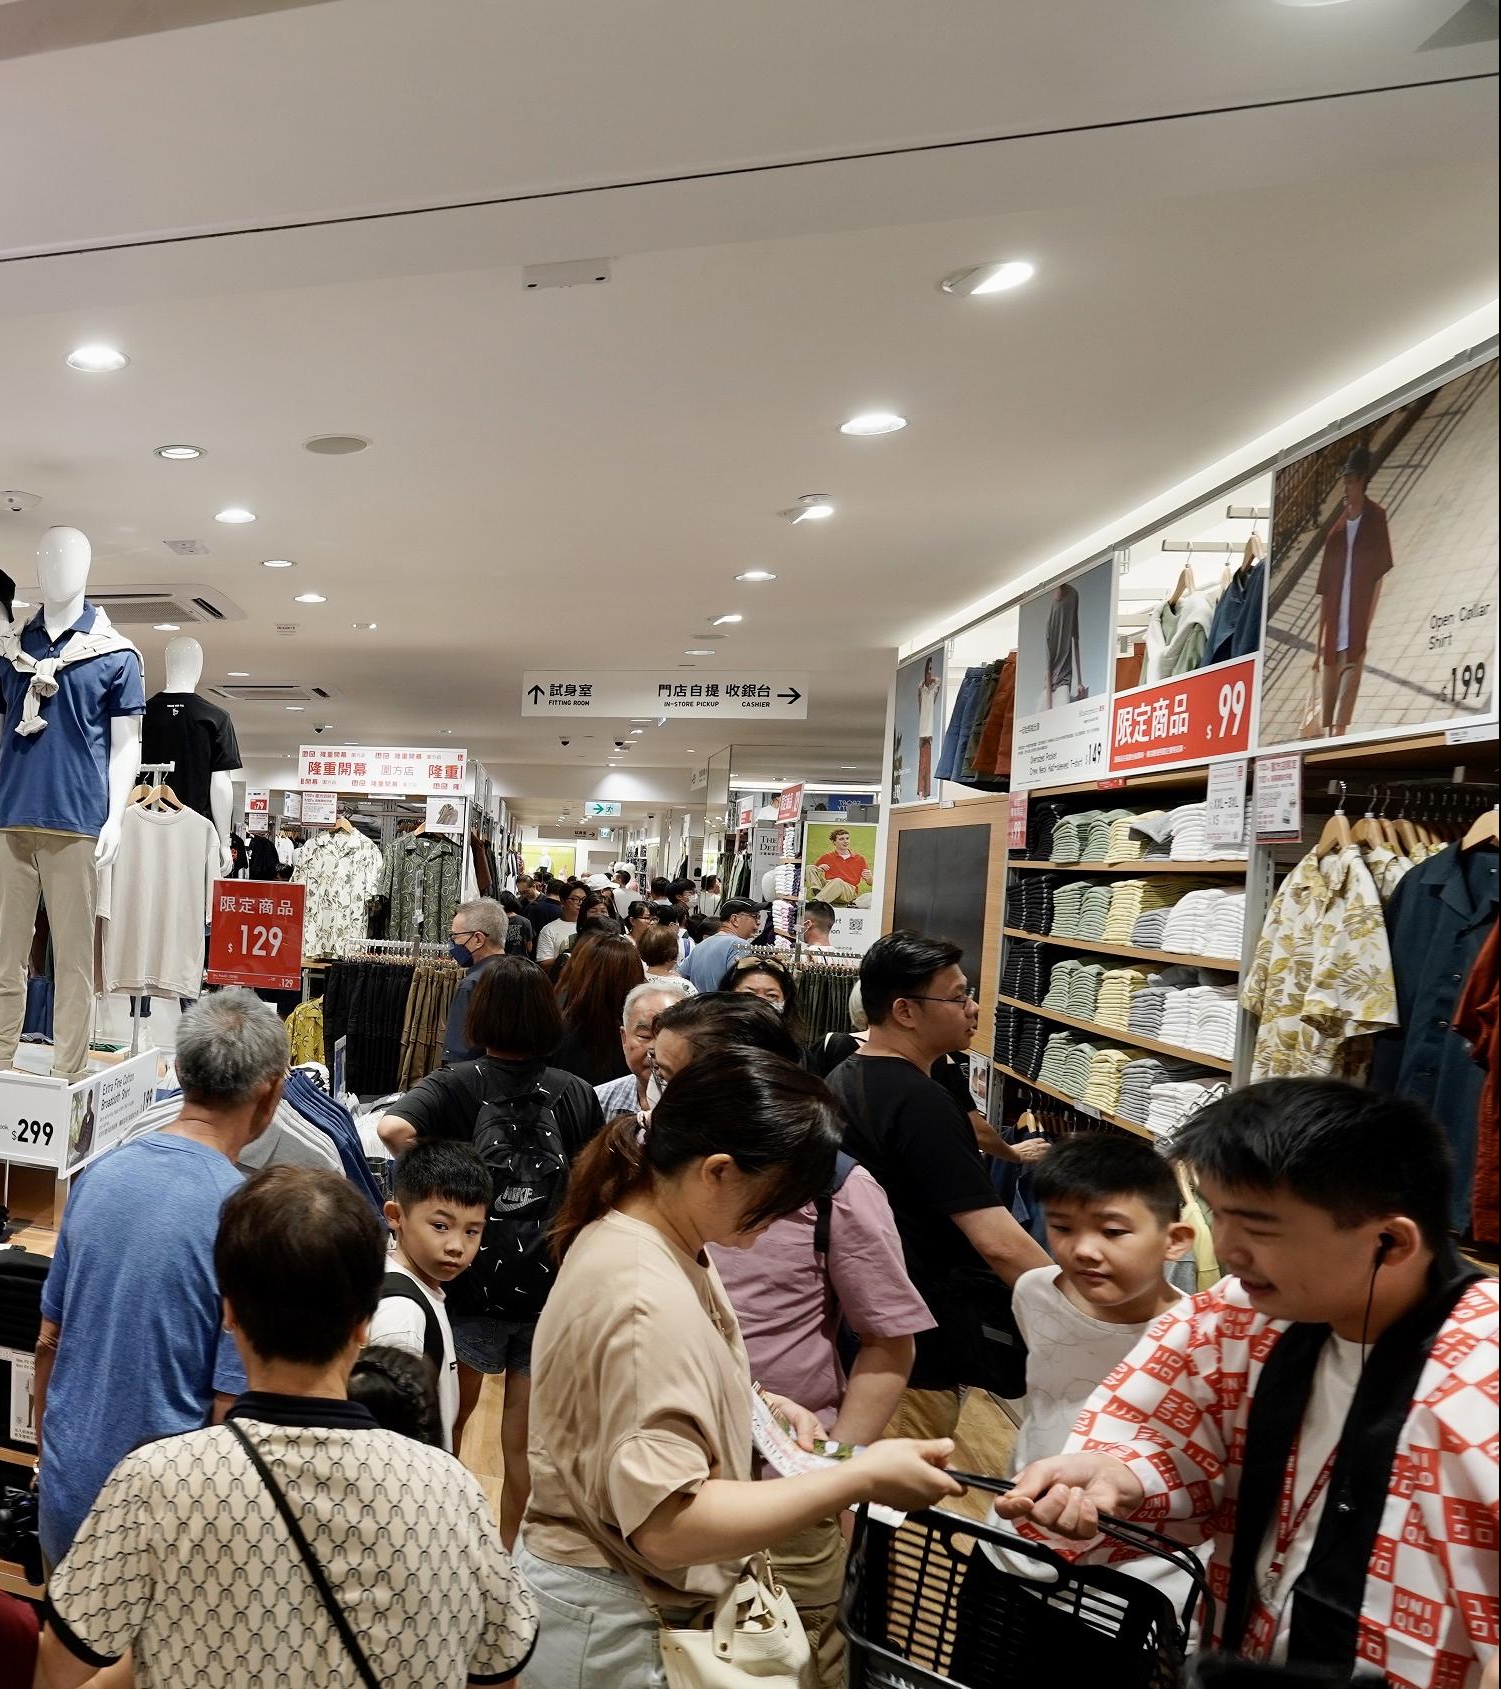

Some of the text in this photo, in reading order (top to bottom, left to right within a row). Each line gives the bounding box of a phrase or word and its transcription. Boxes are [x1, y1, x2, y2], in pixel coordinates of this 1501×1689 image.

[1429, 603, 1491, 632] Open Collar
[1429, 631, 1453, 650] Shirt
[549, 683, 771, 698] 試身室 門店自提 收銀台
[1115, 693, 1190, 747] 限定商品
[1219, 680, 1246, 738] 99
[308, 761, 368, 776] 隆重開幕
[428, 765, 463, 780] 隆重
[220, 895, 294, 916] 限定商品
[240, 925, 283, 957] 129
[102, 1083, 114, 1095] Extra
[502, 1186, 533, 1202] NIKE
[1157, 1394, 1182, 1420] UNI
[1176, 1401, 1197, 1430] QLO
[1395, 1593, 1432, 1619] UNI
[1393, 1611, 1434, 1638] QLO
